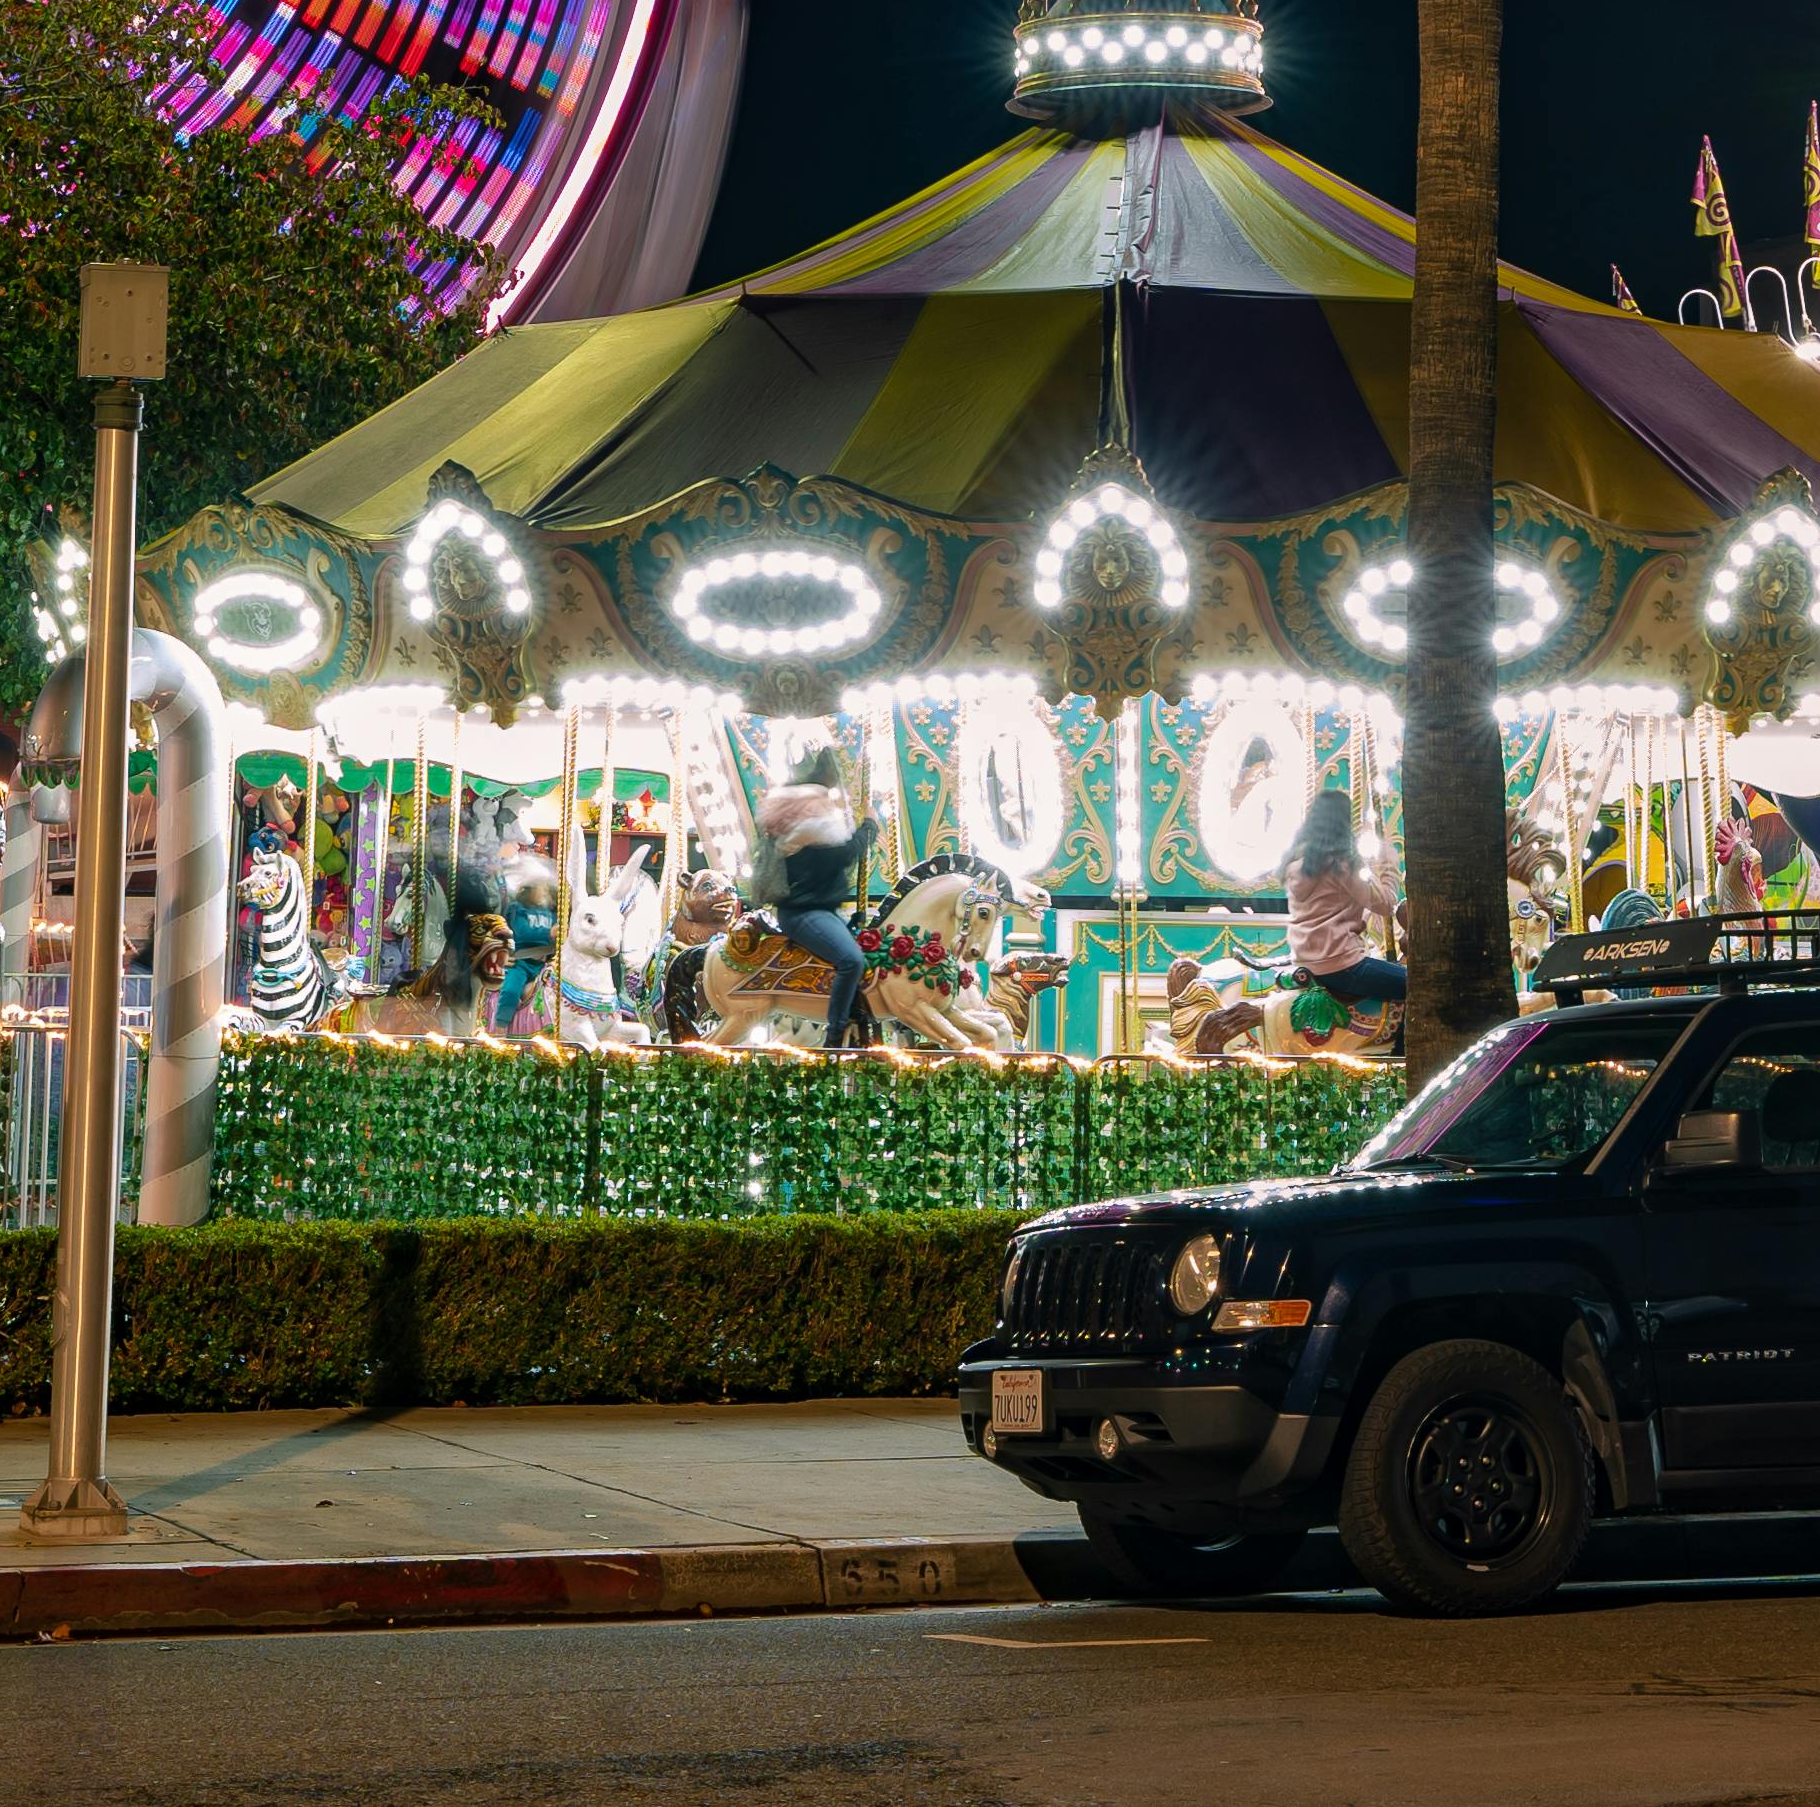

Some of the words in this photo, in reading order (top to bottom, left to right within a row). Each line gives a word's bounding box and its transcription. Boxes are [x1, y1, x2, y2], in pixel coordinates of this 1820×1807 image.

[1589, 938, 1663, 962] ARKSEN
[1687, 1348, 1795, 1363] PATRIOT
[994, 1394, 1038, 1423] 7UKU199
[840, 1557, 944, 1596] 650
